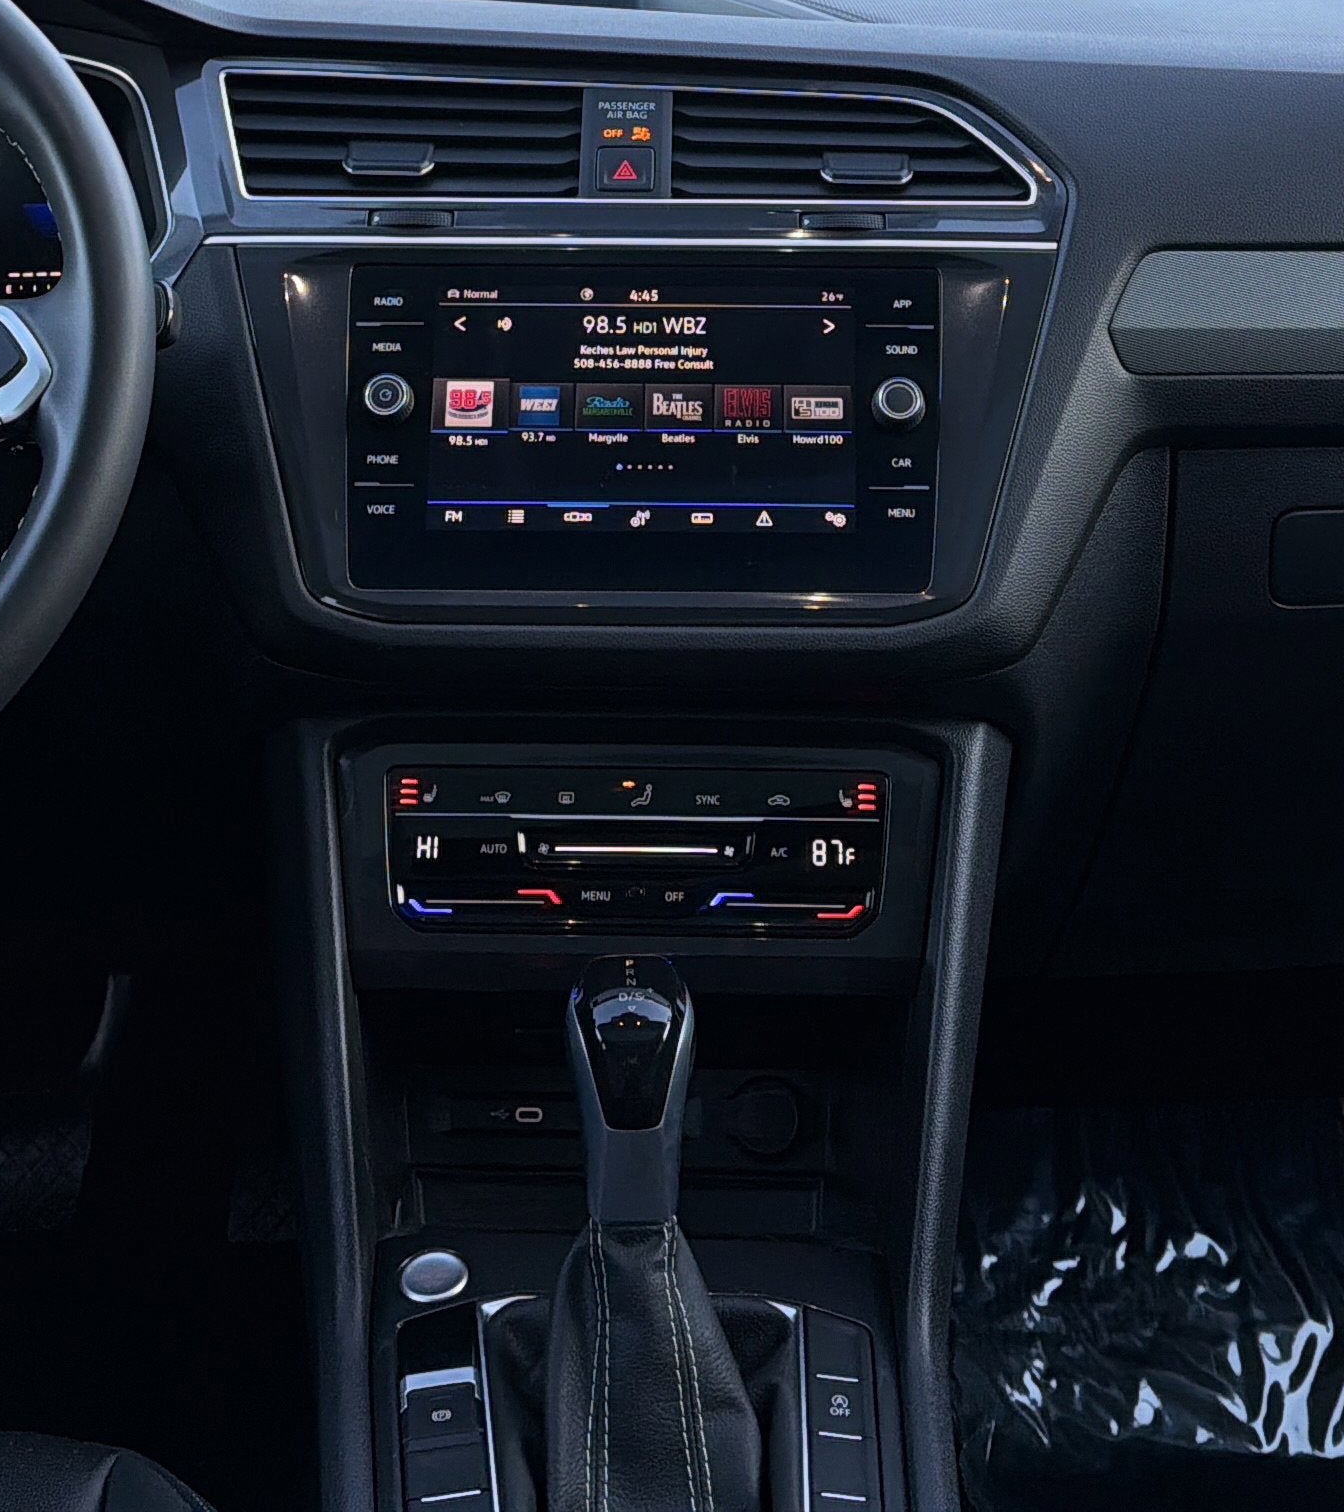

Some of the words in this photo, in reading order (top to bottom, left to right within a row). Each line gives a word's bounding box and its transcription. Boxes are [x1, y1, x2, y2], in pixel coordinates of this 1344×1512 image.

[597, 101, 656, 111] PASSENGER
[606, 110, 624, 120] AIR
[625, 110, 648, 120] BAG
[602, 128, 624, 138] OFF
[463, 289, 498, 299] Normal
[629, 290, 659, 302] 4:45
[373, 297, 404, 307] RADIO
[892, 299, 913, 310] APP
[582, 315, 627, 335] 98.5
[632, 321, 657, 334] HD1
[662, 316, 707, 335] WBZ
[372, 342, 402, 352] MEDIA
[580, 345, 614, 356] Keches
[616, 345, 636, 356] Law
[637, 345, 678, 356] Personal
[680, 345, 708, 358] Injury
[885, 345, 918, 355] SOUND
[573, 358, 652, 369] 508-456-8888
[654, 359, 676, 369] Free
[677, 359, 714, 370] Consult
[448, 389, 492, 410] 98.5
[723, 388, 772, 418] ELVIS
[724, 419, 771, 428] RADIO
[448, 435, 473, 446] 98.5
[521, 431, 544, 443] 93.7
[661, 433, 696, 445] Beatles
[737, 434, 760, 445] Elvis
[366, 454, 399, 465] PHONE
[891, 458, 912, 468] CAR
[366, 504, 396, 515] VOICE
[887, 508, 916, 518] MENU
[444, 510, 463, 523] FM
[479, 795, 495, 803] MAX
[695, 794, 721, 806] SYNC
[416, 835, 439, 859] HI
[479, 843, 508, 854] AUTO
[770, 846, 788, 858] A/C
[580, 890, 612, 902] MENU
[664, 891, 685, 902] OFF
[625, 959, 634, 967] P
[625, 968, 635, 976] R
[626, 977, 637, 986] N
[829, 1406, 851, 1417] OFF
